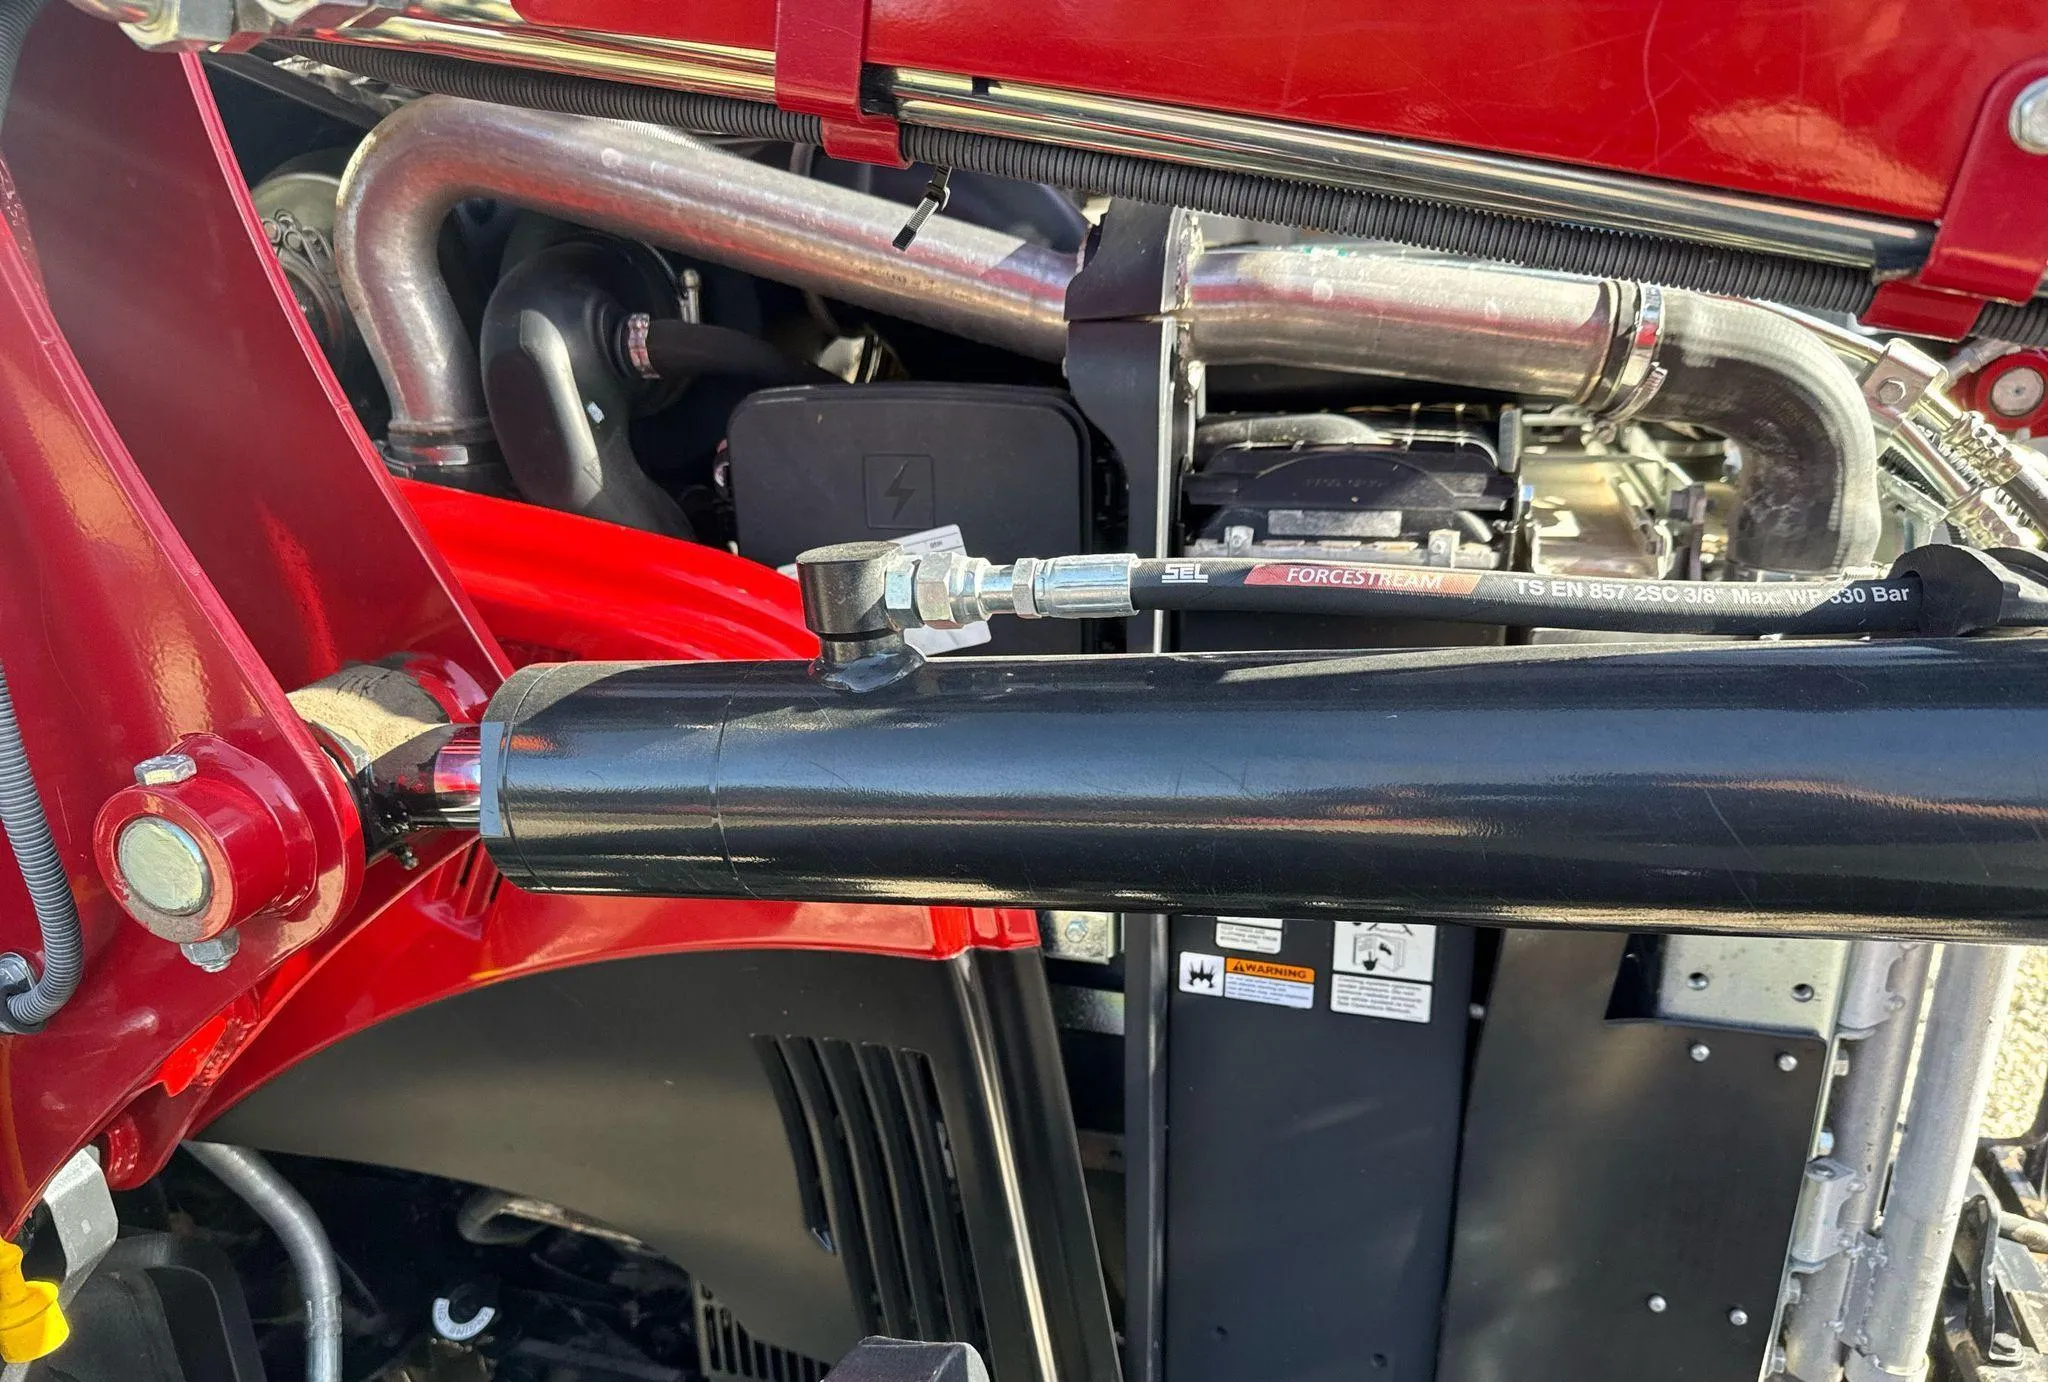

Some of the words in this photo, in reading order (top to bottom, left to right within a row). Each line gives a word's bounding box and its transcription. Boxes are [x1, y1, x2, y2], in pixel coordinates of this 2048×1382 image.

[1161, 563, 1208, 583] SEL
[1286, 567, 1443, 590] FORCESTREAM
[1514, 579, 1545, 597] TS
[1551, 581, 1583, 598] EN
[1588, 583, 1626, 601] 857
[1634, 585, 1678, 603] 2SC
[1684, 586, 1724, 605] 3/8"
[1787, 589, 1821, 605] WP
[1829, 586, 1866, 605] 330
[1871, 586, 1909, 604] Bar
[1245, 963, 1307, 980] WARNING
